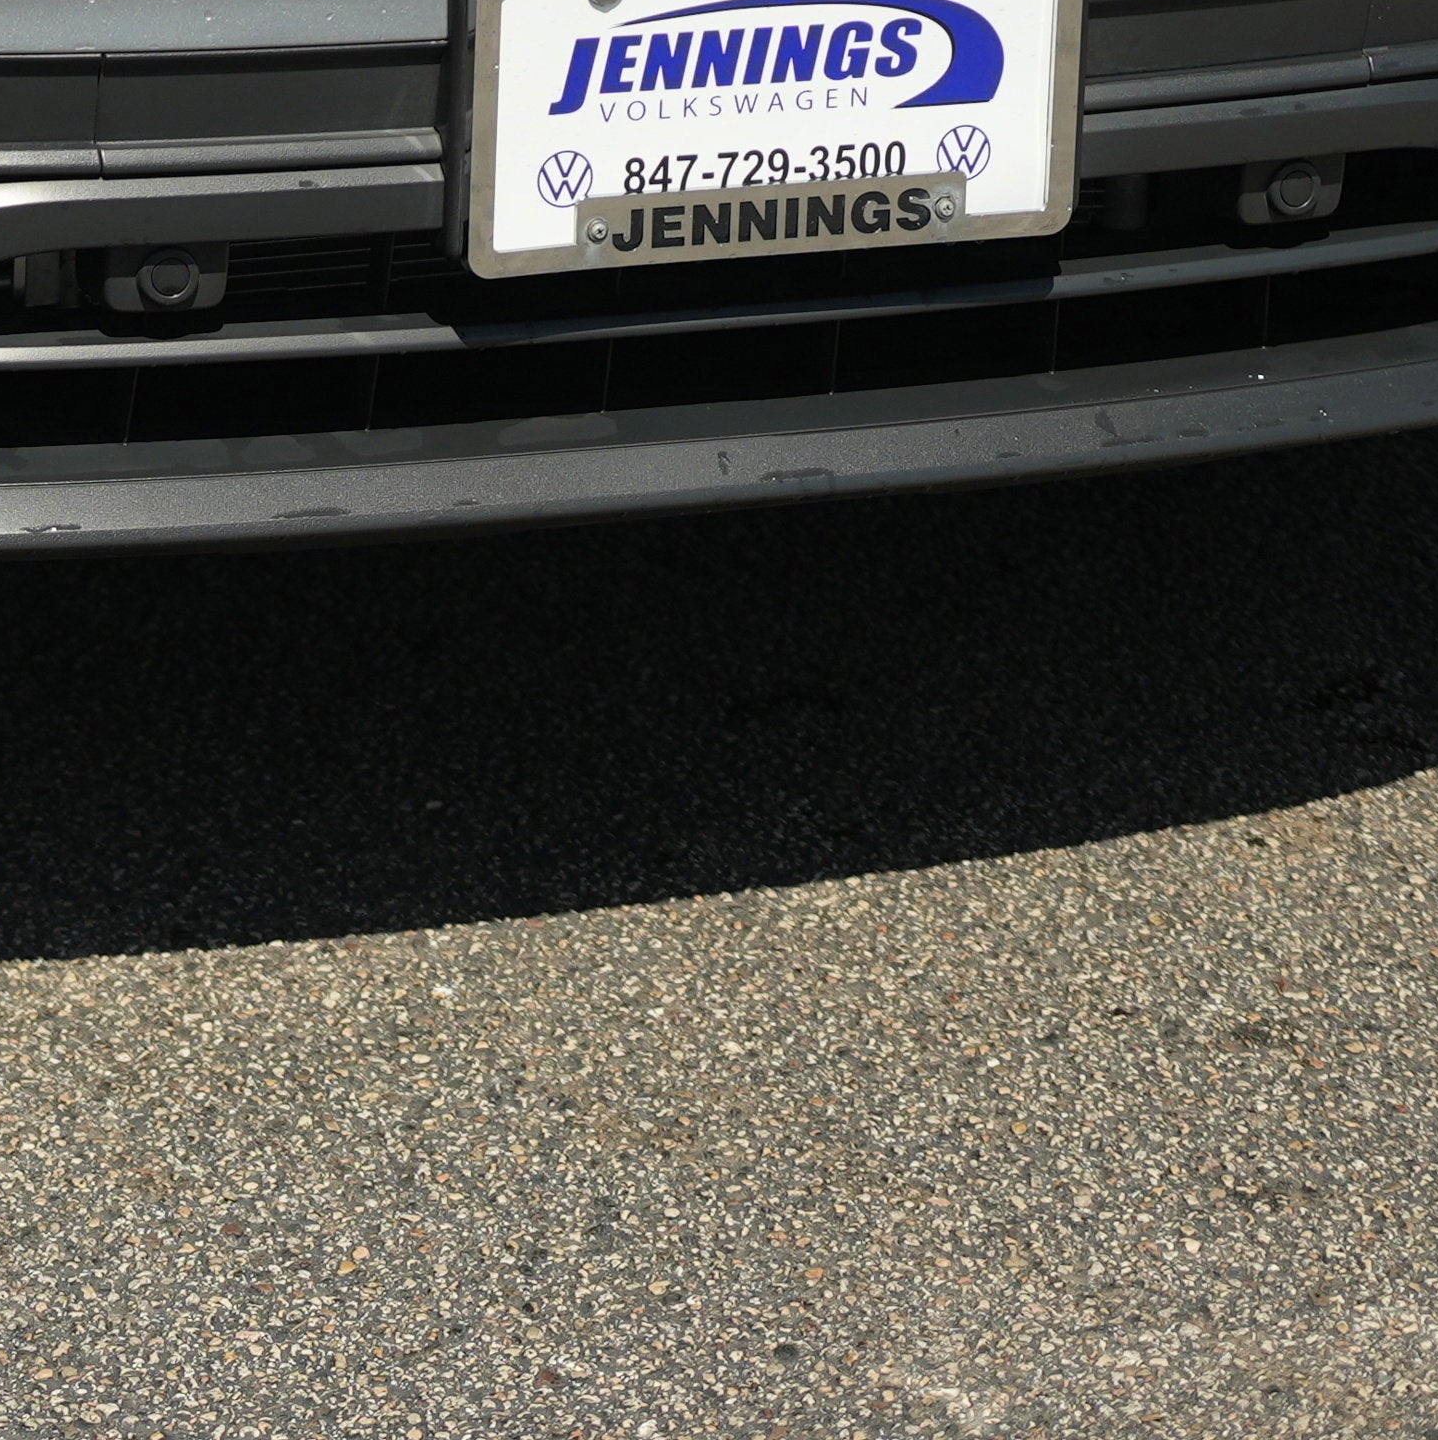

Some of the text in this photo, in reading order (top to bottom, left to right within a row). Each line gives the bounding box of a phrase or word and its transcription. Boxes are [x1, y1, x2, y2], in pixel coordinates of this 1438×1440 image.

[548, 17, 922, 115] JENNINGS
[600, 87, 868, 122] VOLKSWAGEN
[624, 141, 906, 195] 847-729-3500
[612, 187, 932, 252] JENNINGS
